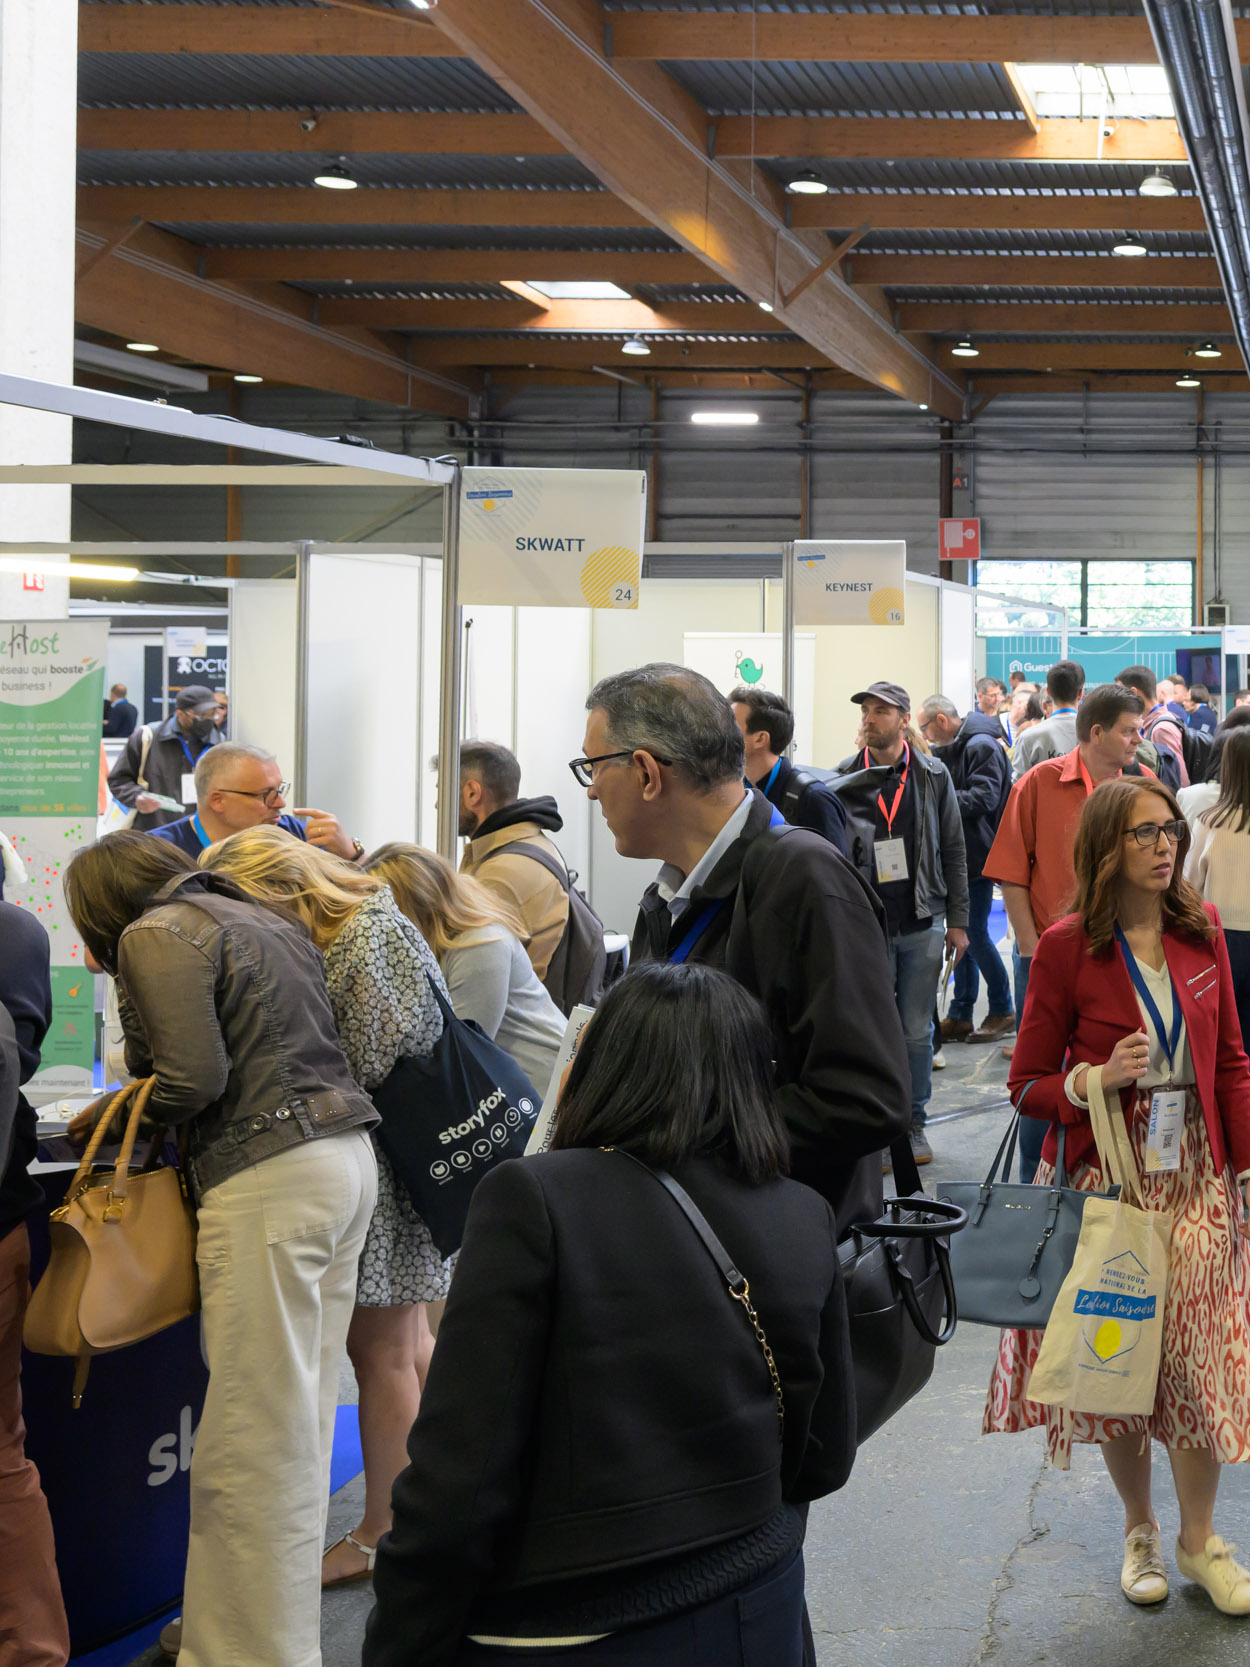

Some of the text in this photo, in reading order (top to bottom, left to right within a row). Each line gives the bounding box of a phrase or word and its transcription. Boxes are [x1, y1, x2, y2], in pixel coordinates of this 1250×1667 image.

[953, 477, 968, 487] A1
[515, 537, 586, 552] SKWATT
[825, 583, 873, 592] KEYNEST
[615, 589, 632, 601] 24
[890, 613, 901, 621] 16
[0, 625, 60, 659] eHost
[0, 665, 84, 677] éseau qui booste
[1024, 663, 1053, 672] Guest
[2, 681, 46, 691] business
[439, 1087, 506, 1145] storyfox
[1150, 1099, 1160, 1135] SALON
[1099, 1277, 1125, 1290] NATIONAL
